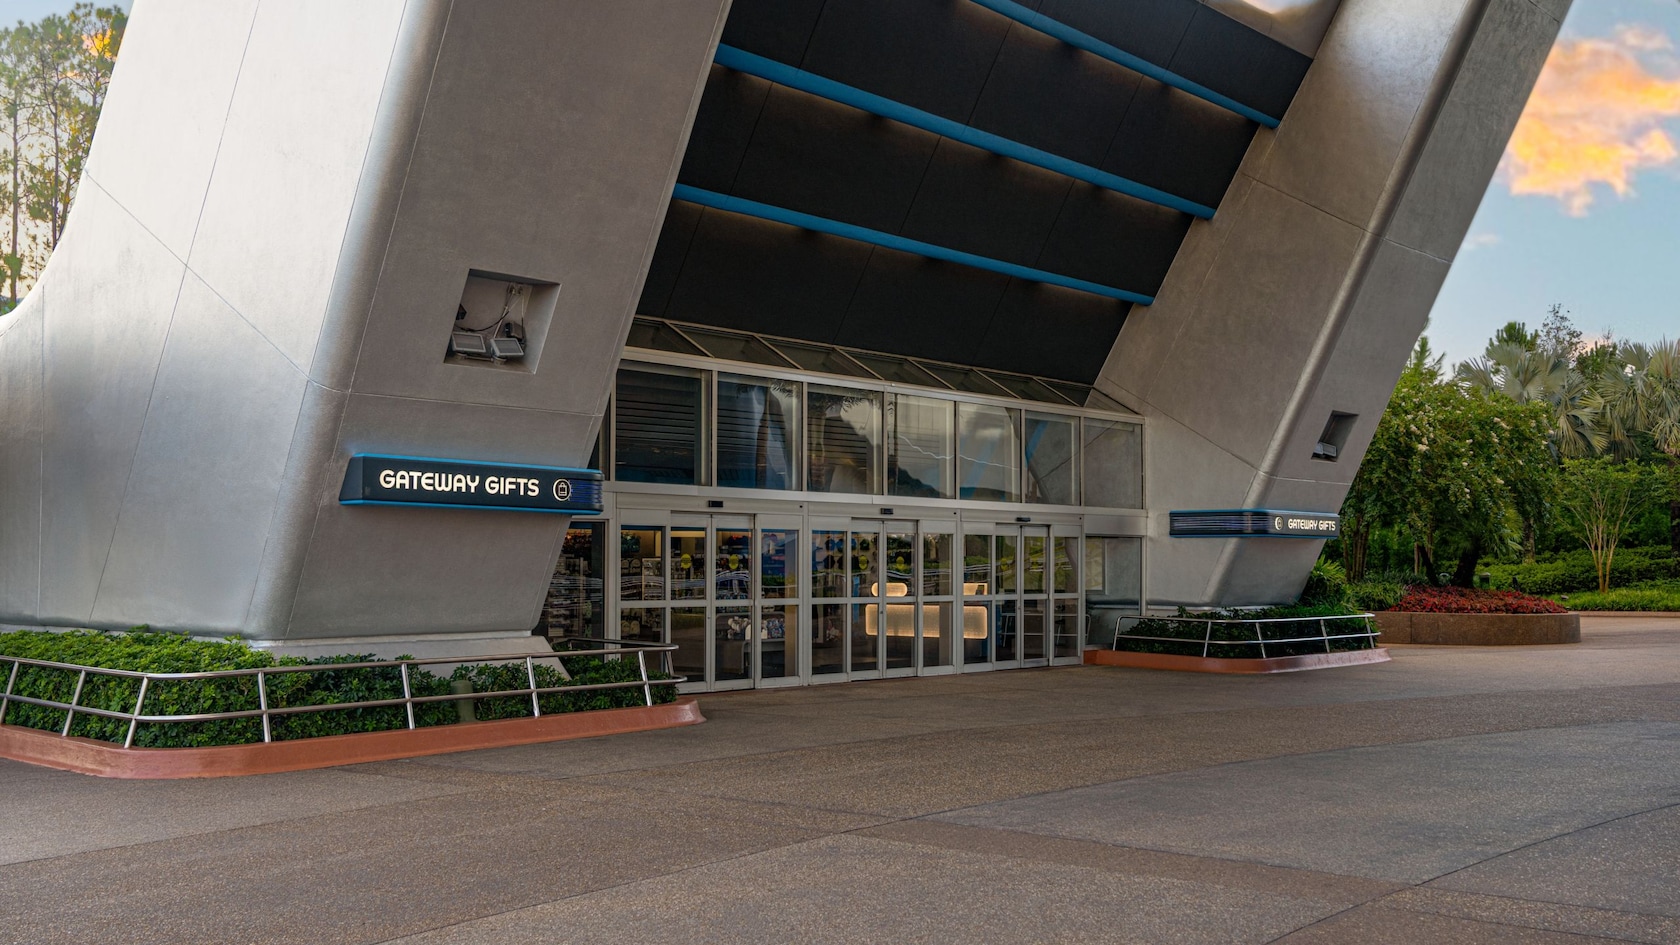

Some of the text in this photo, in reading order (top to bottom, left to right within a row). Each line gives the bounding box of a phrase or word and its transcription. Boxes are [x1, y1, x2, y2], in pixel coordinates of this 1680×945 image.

[379, 469, 540, 496] GATEWAY GIFTS
[1288, 519, 1336, 531] GATEWAY GIFTS
